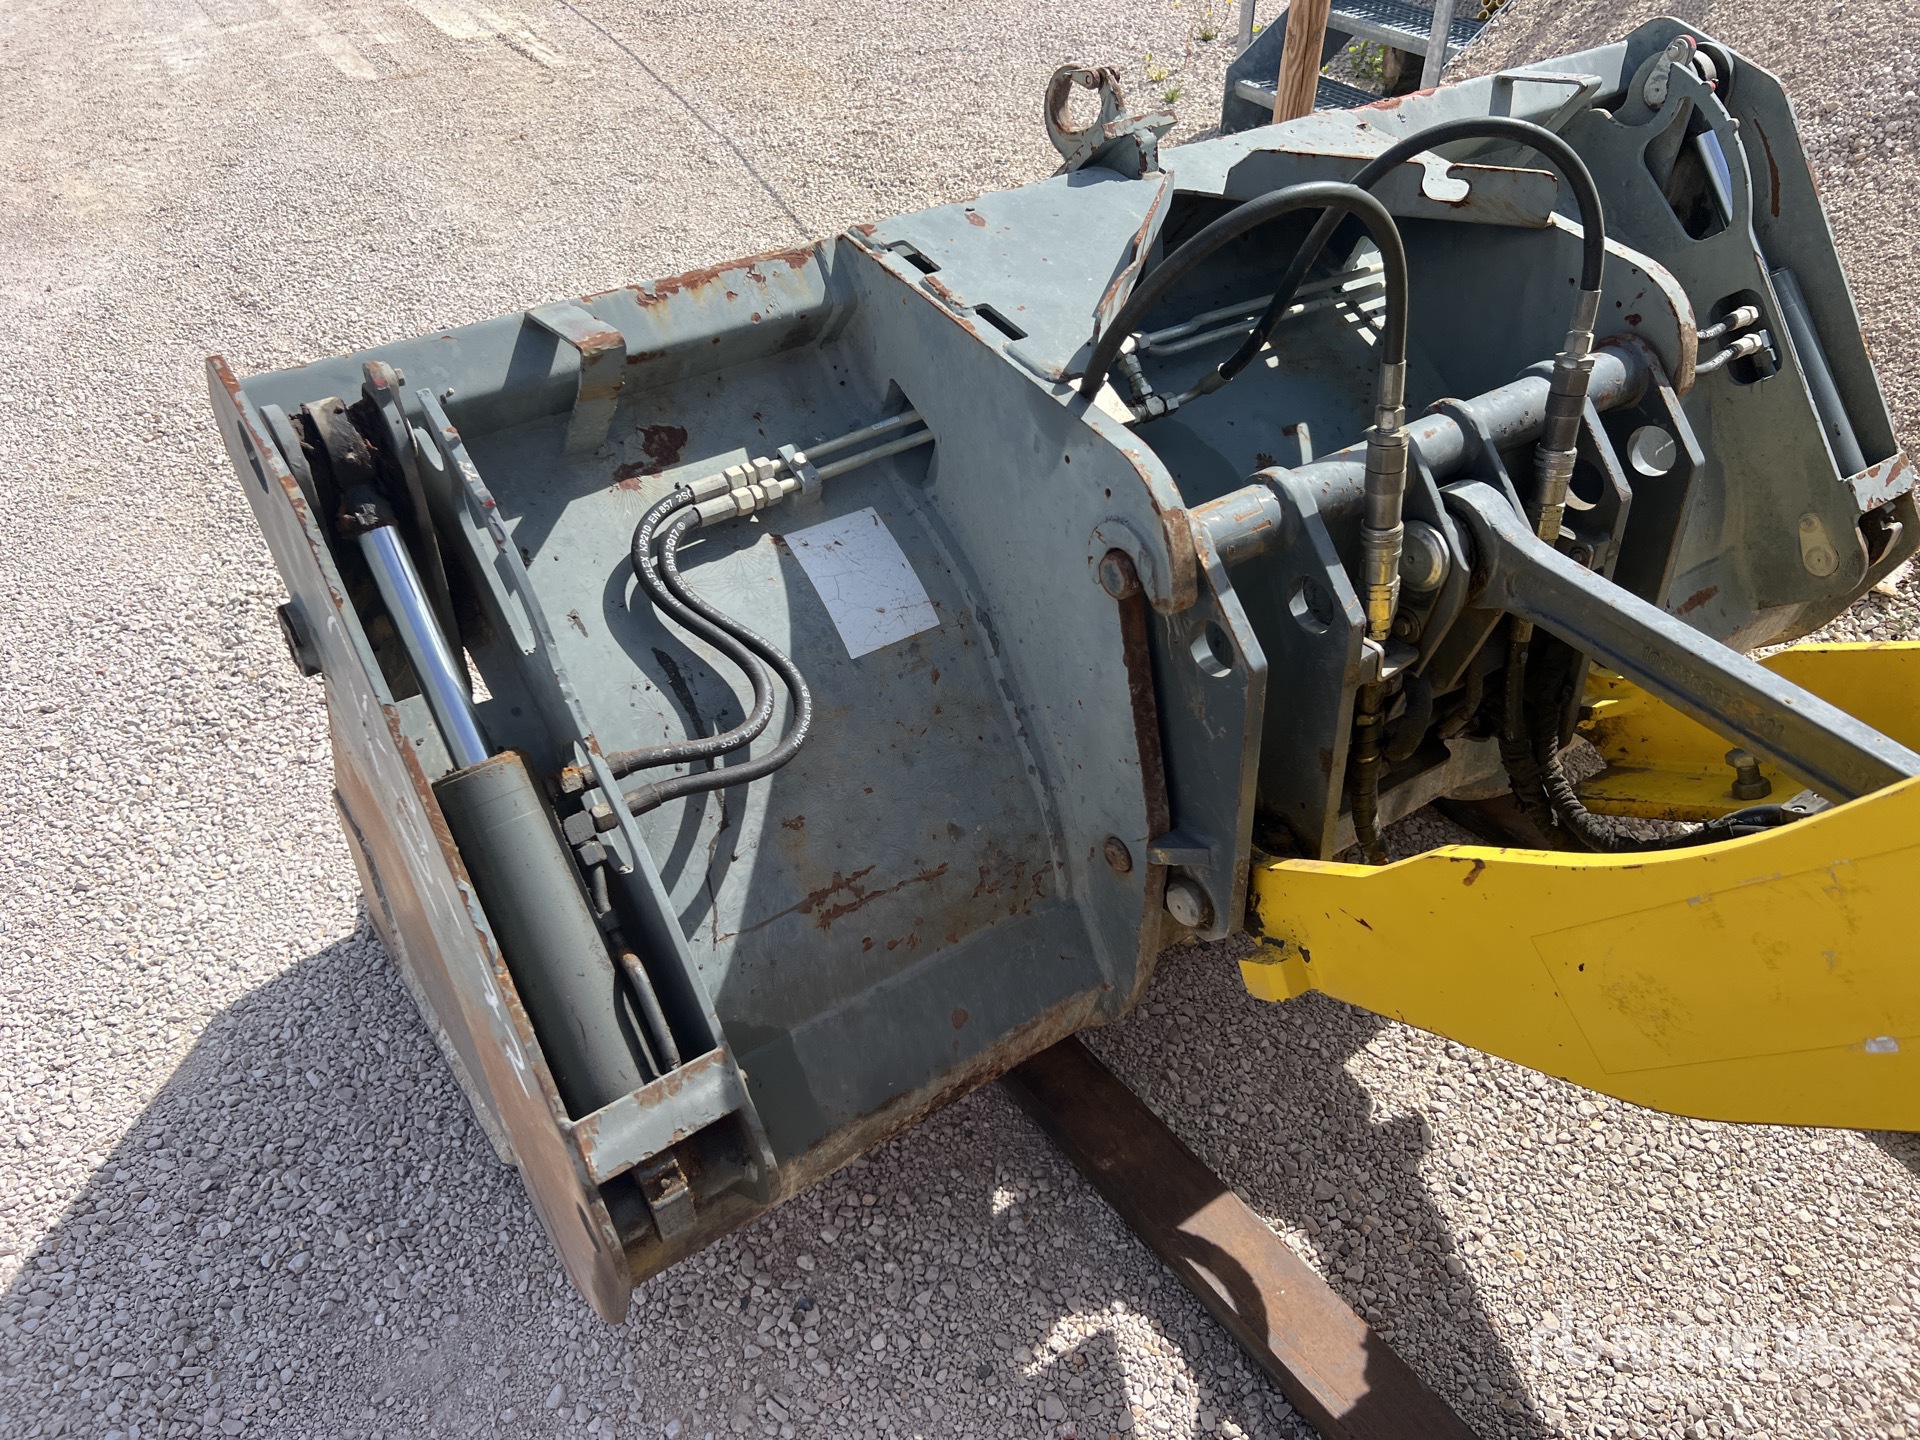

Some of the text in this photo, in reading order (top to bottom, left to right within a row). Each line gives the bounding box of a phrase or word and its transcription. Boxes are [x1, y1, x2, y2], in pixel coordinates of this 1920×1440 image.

[659, 499, 674, 514] 857
[648, 510, 661, 525] EN
[639, 525, 652, 552] KP210
[665, 551, 677, 572] BAR
[640, 556, 682, 608] HANSA-FLEX
[673, 575, 688, 591] 330
[792, 684, 812, 748] HANSA-FLEX
[720, 735, 741, 749] 330
